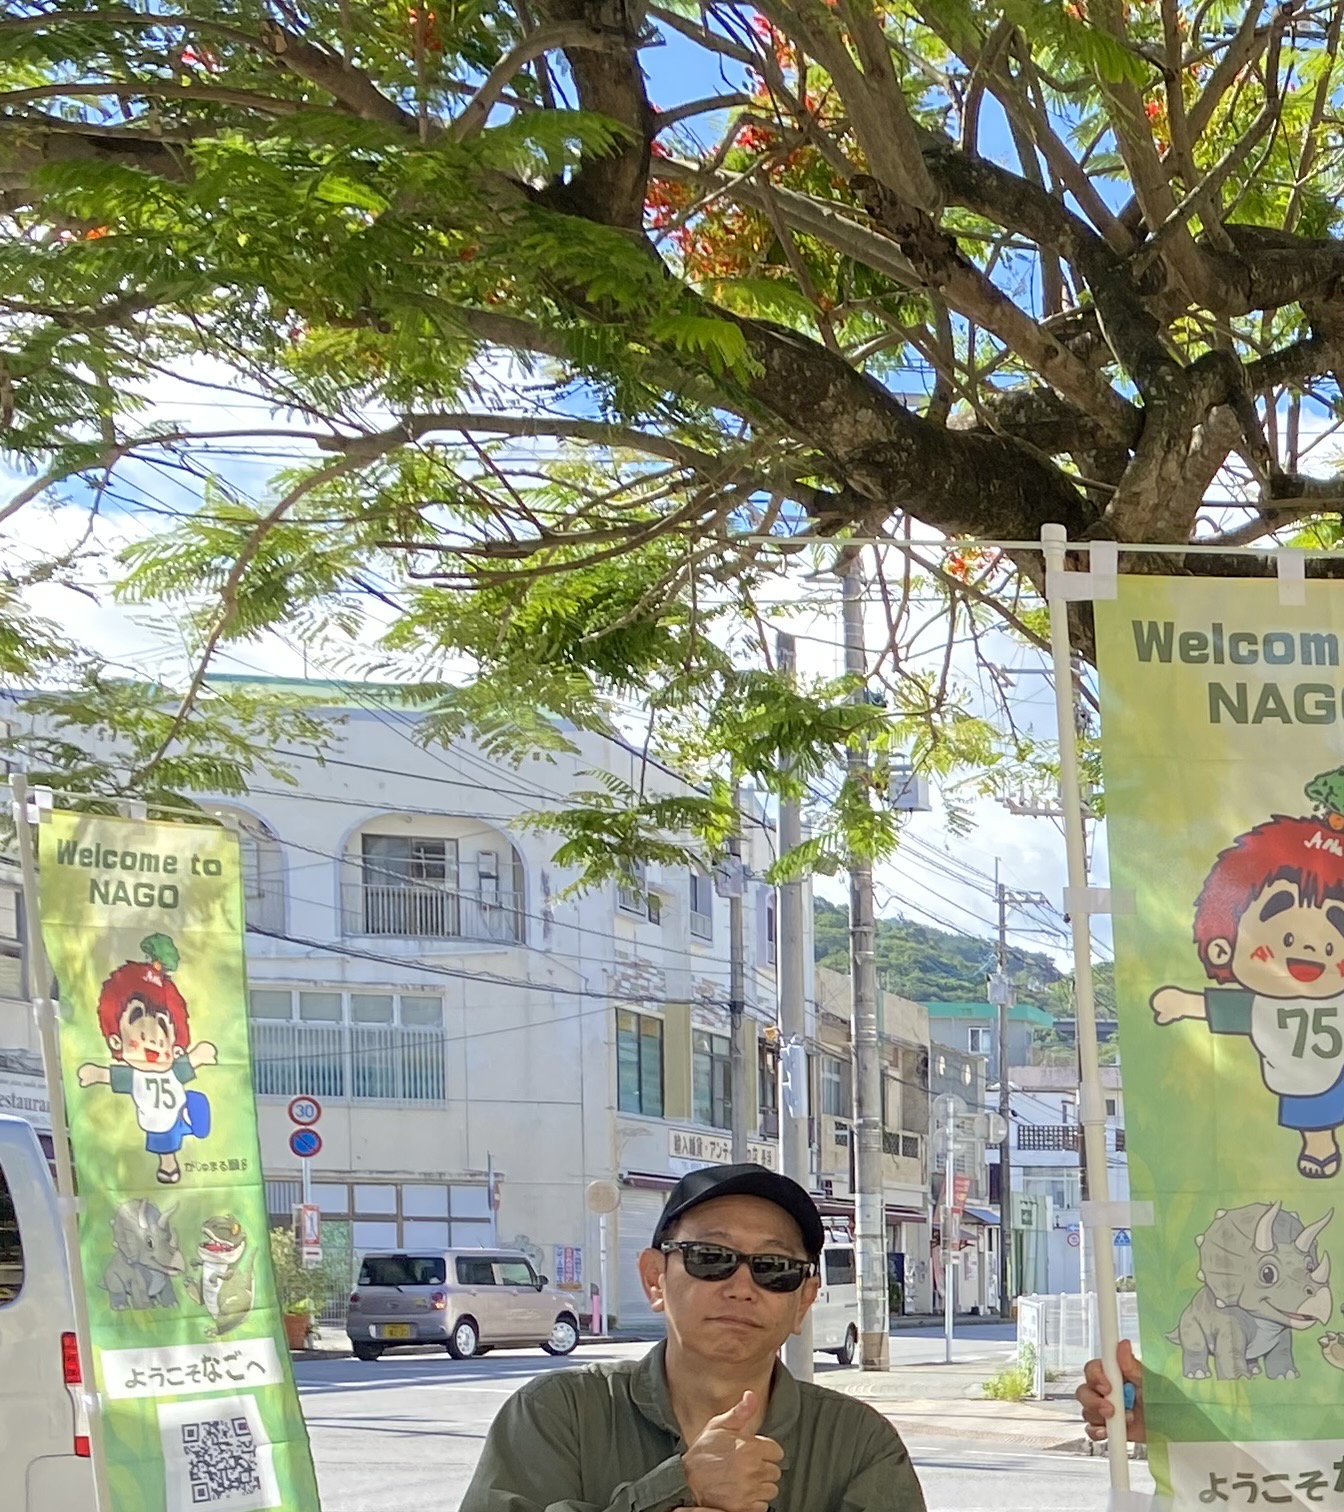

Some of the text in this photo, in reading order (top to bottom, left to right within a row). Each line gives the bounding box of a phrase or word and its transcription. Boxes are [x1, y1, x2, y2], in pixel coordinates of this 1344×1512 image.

[56, 838, 222, 877] Welcome to
[88, 878, 180, 910] NAGO
[1276, 1006, 1343, 1060] 75
[145, 1077, 177, 1111] 75
[294, 1104, 314, 1119] 30
[125, 1350, 266, 1389] ようこそなごへ
